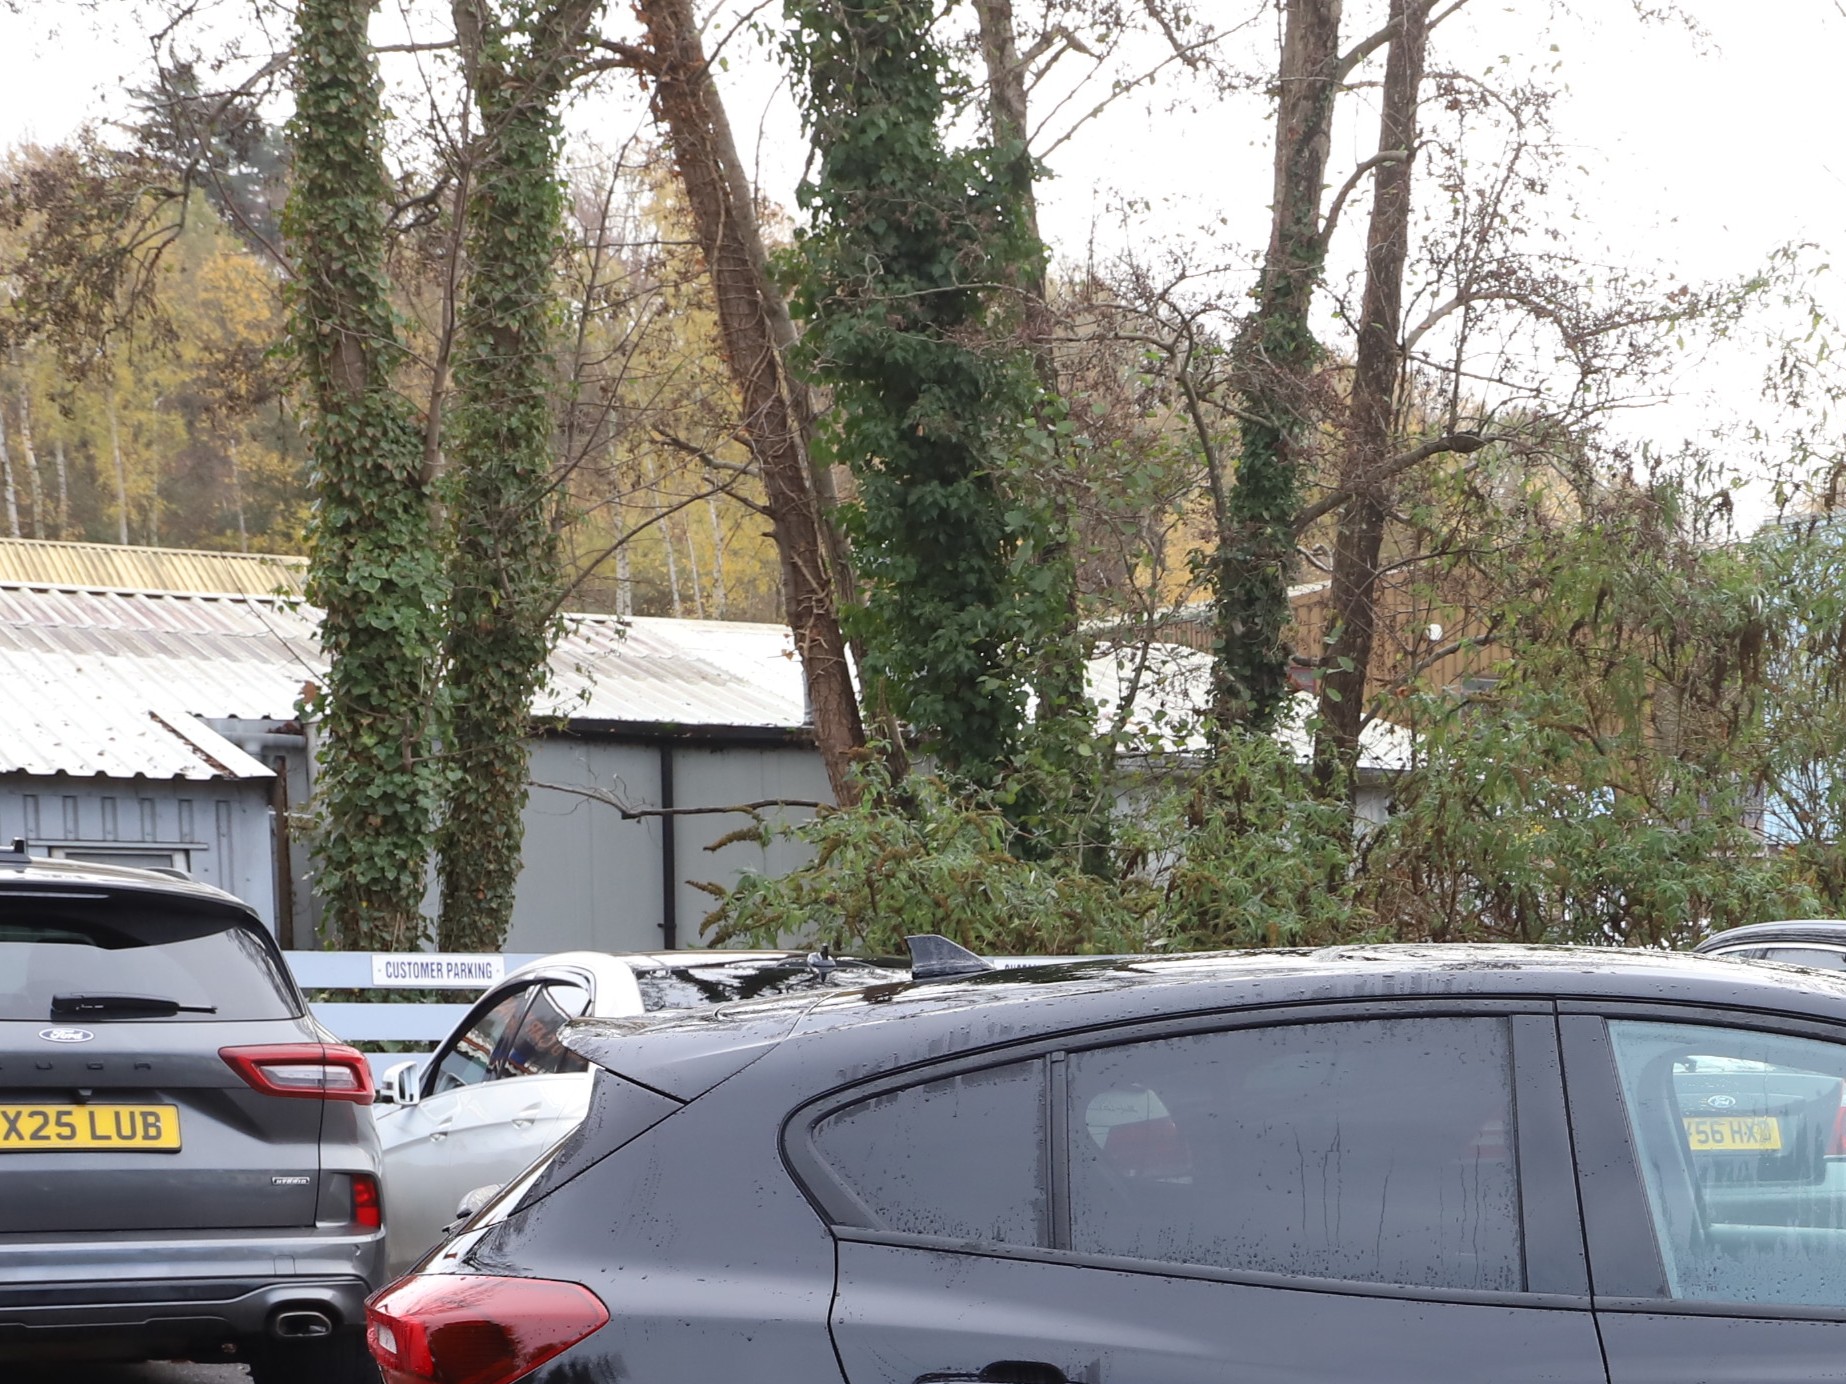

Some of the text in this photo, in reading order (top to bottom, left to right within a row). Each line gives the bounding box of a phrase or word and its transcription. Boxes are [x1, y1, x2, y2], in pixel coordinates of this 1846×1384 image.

[385, 961, 493, 979] CUSTOMER PARKING
[50, 1029, 84, 1041] Ford
[0, 1060, 152, 1071] UGA
[0, 1110, 162, 1141] X25 LUB
